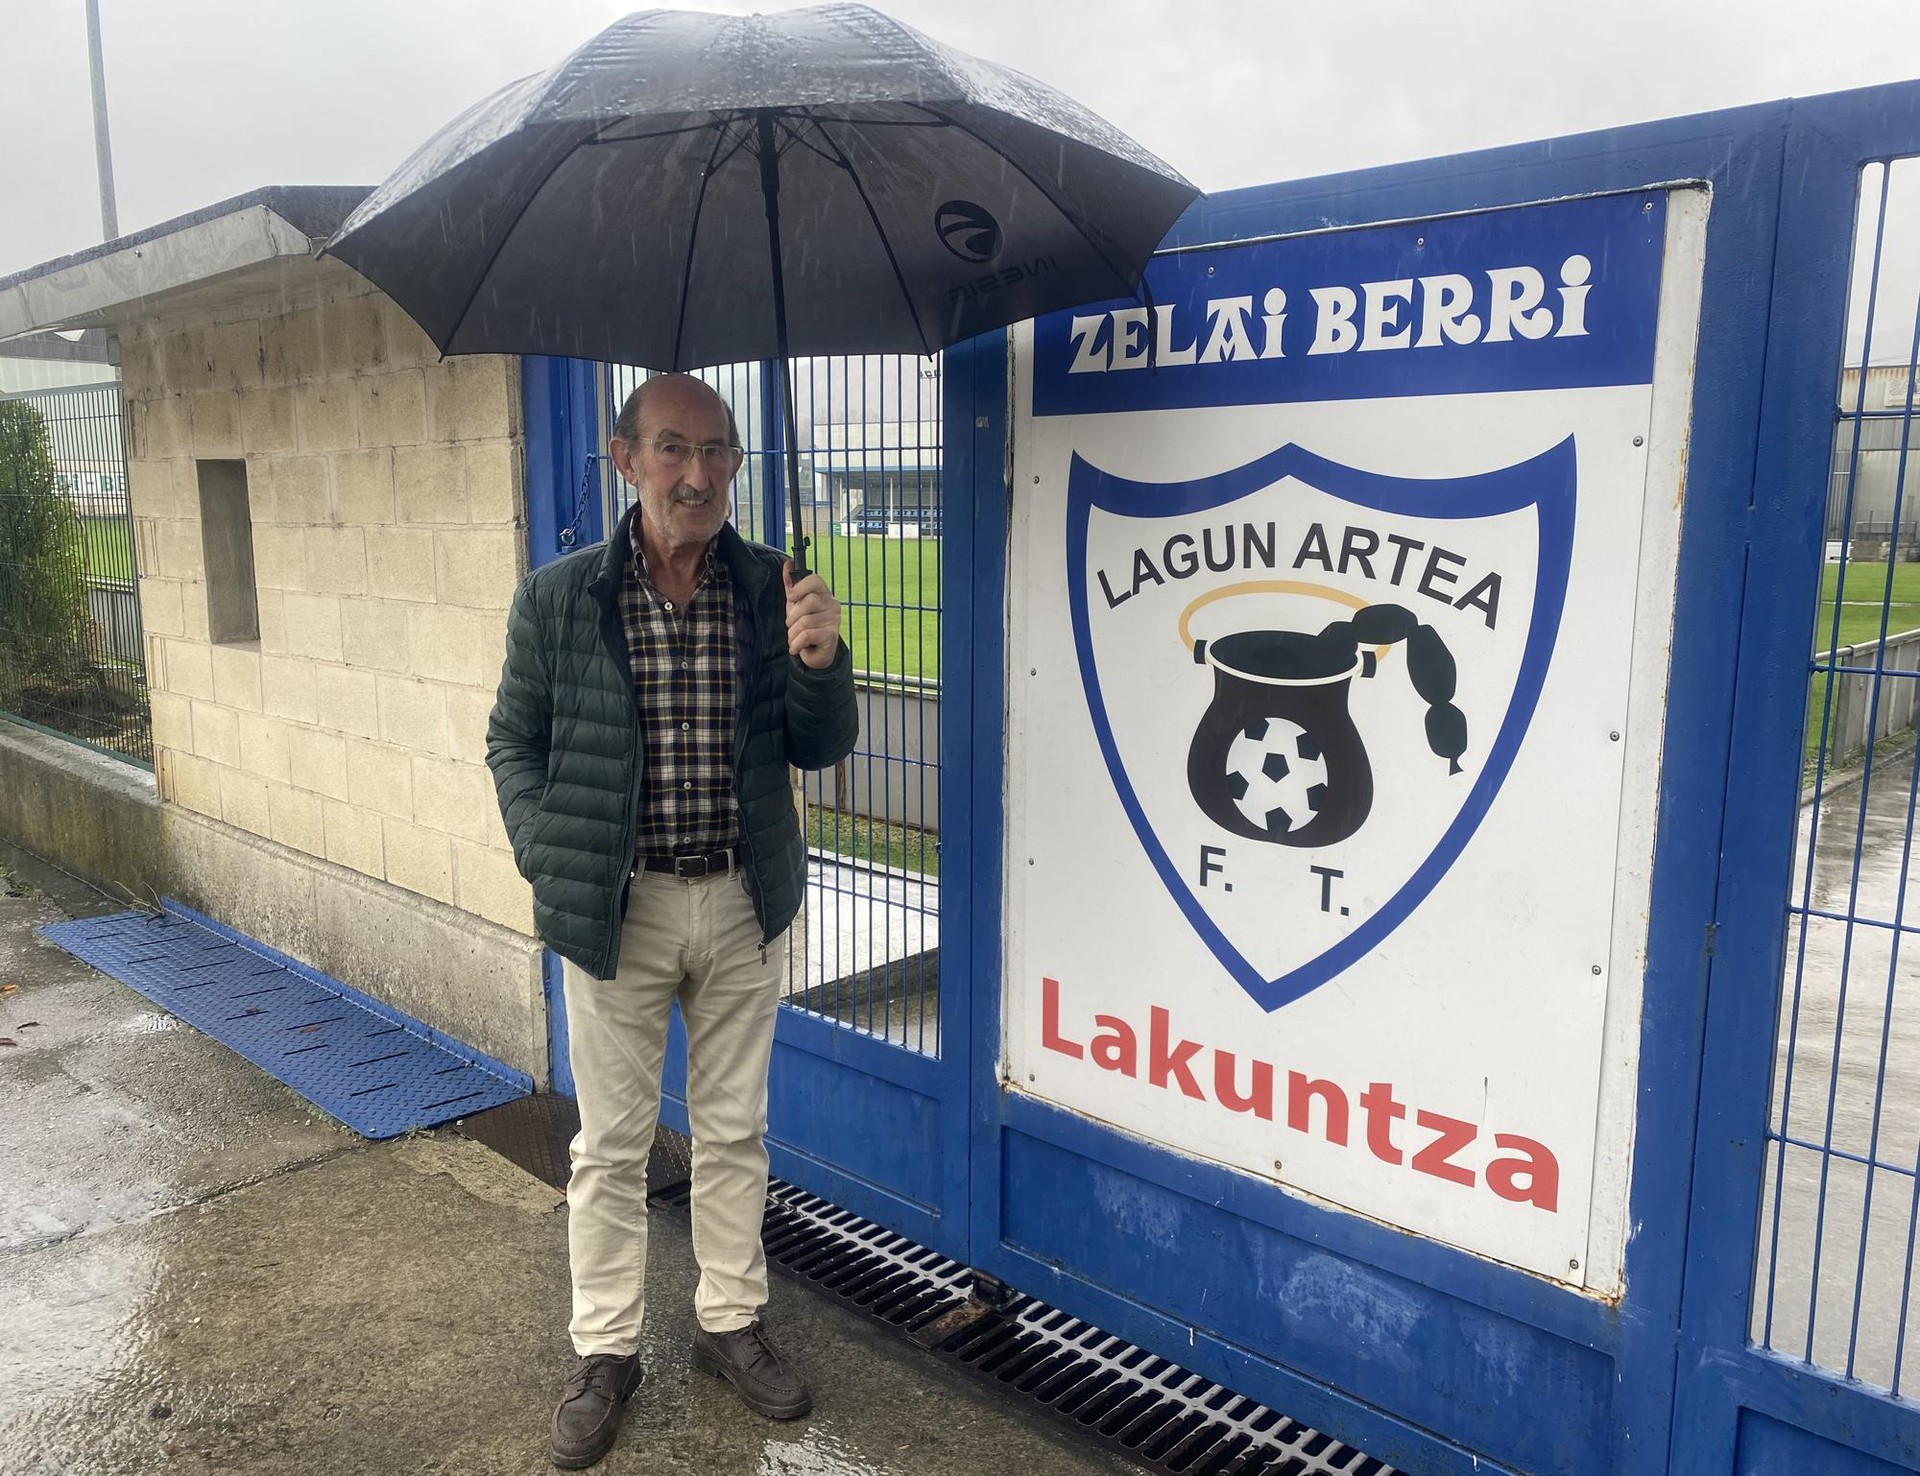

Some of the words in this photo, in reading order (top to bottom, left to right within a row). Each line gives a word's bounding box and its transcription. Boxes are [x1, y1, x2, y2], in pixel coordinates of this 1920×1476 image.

[1097, 522, 1276, 609] LAGUN
[1292, 523, 1502, 631] ARTEA
[1199, 844, 1233, 892] F.
[1310, 865, 1349, 916] T.
[1042, 977, 1559, 1213] Lakuntza
